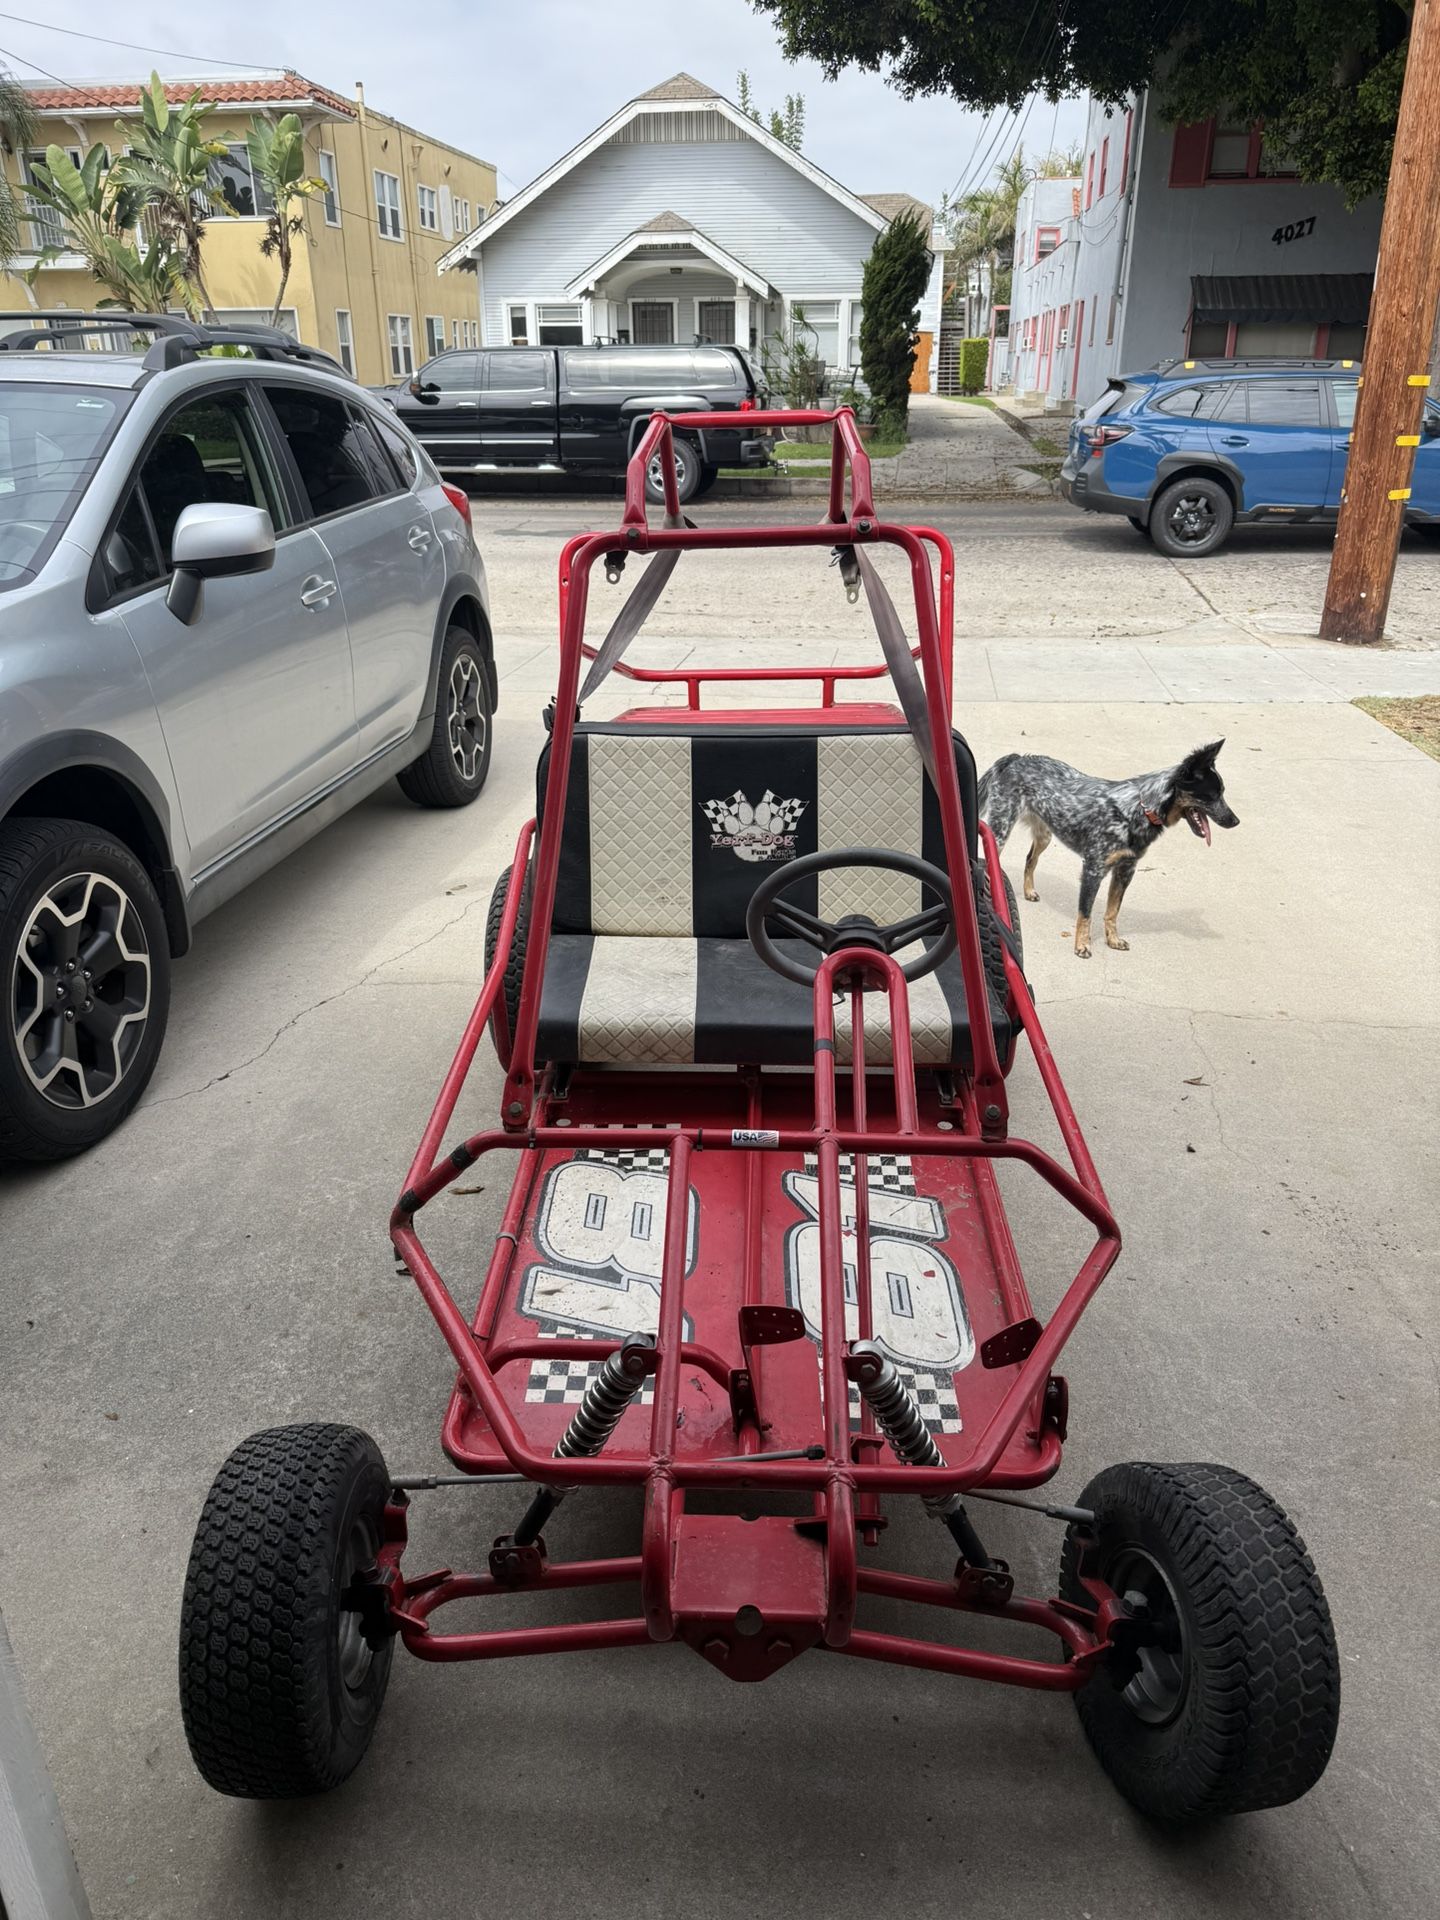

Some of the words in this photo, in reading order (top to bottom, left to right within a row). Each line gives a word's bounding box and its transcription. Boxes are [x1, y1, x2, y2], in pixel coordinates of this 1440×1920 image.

[1272, 216, 1316, 245] 4027
[709, 833, 796, 849] Yerf-Dog
[733, 1131, 758, 1141] USA
